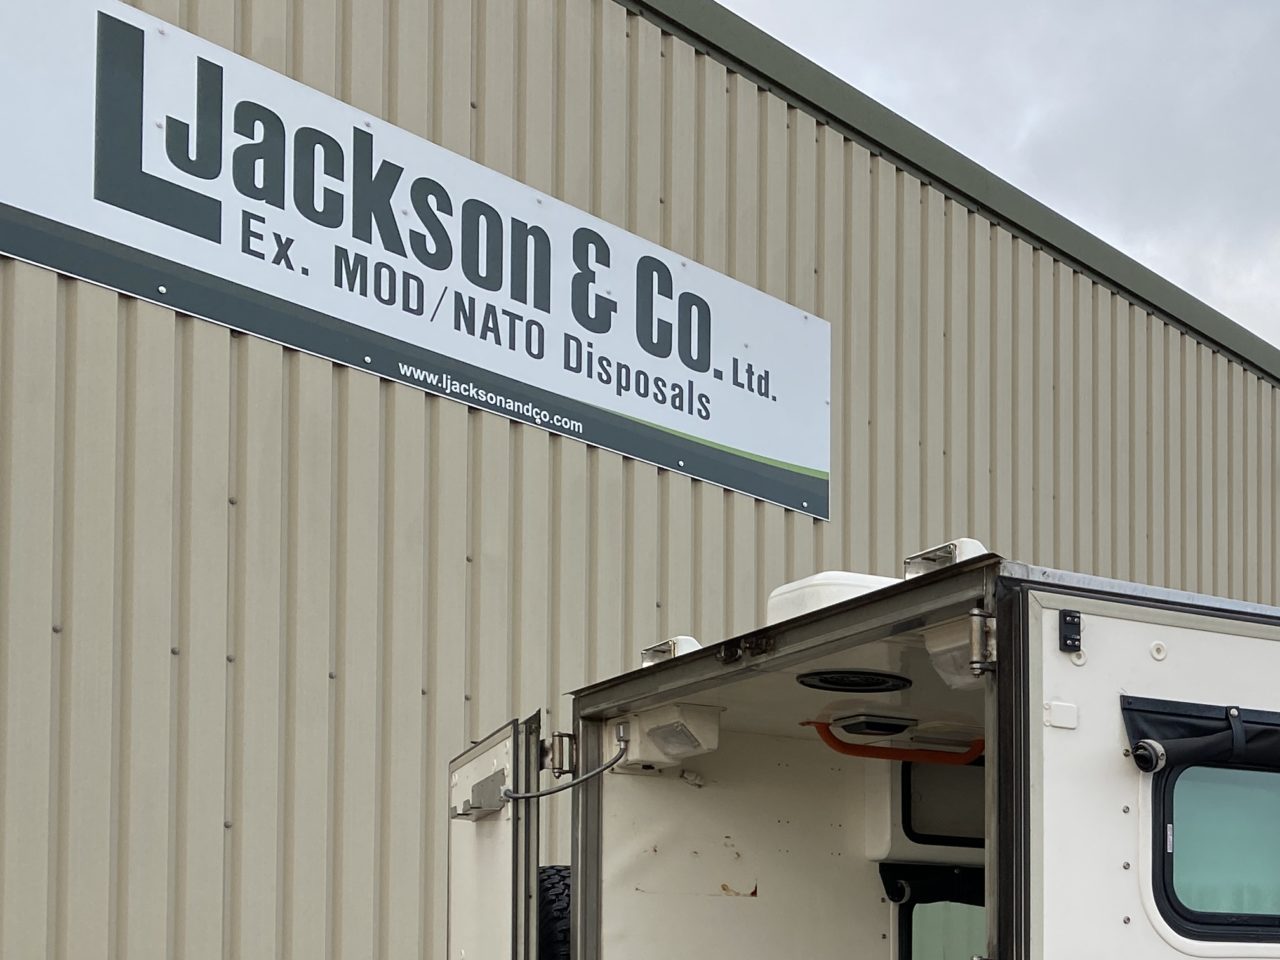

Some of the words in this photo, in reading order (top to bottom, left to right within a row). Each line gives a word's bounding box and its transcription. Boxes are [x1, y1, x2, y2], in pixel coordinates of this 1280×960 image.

[241, 209, 309, 277] Ex.
[334, 244, 546, 360] MOD/NATO
[563, 332, 712, 421] Disposals
[398, 362, 583, 434] www.ljacksonandco.com
[571, 227, 618, 335] &
[635, 255, 724, 382] Co.
[732, 356, 779, 403] Ltd.
